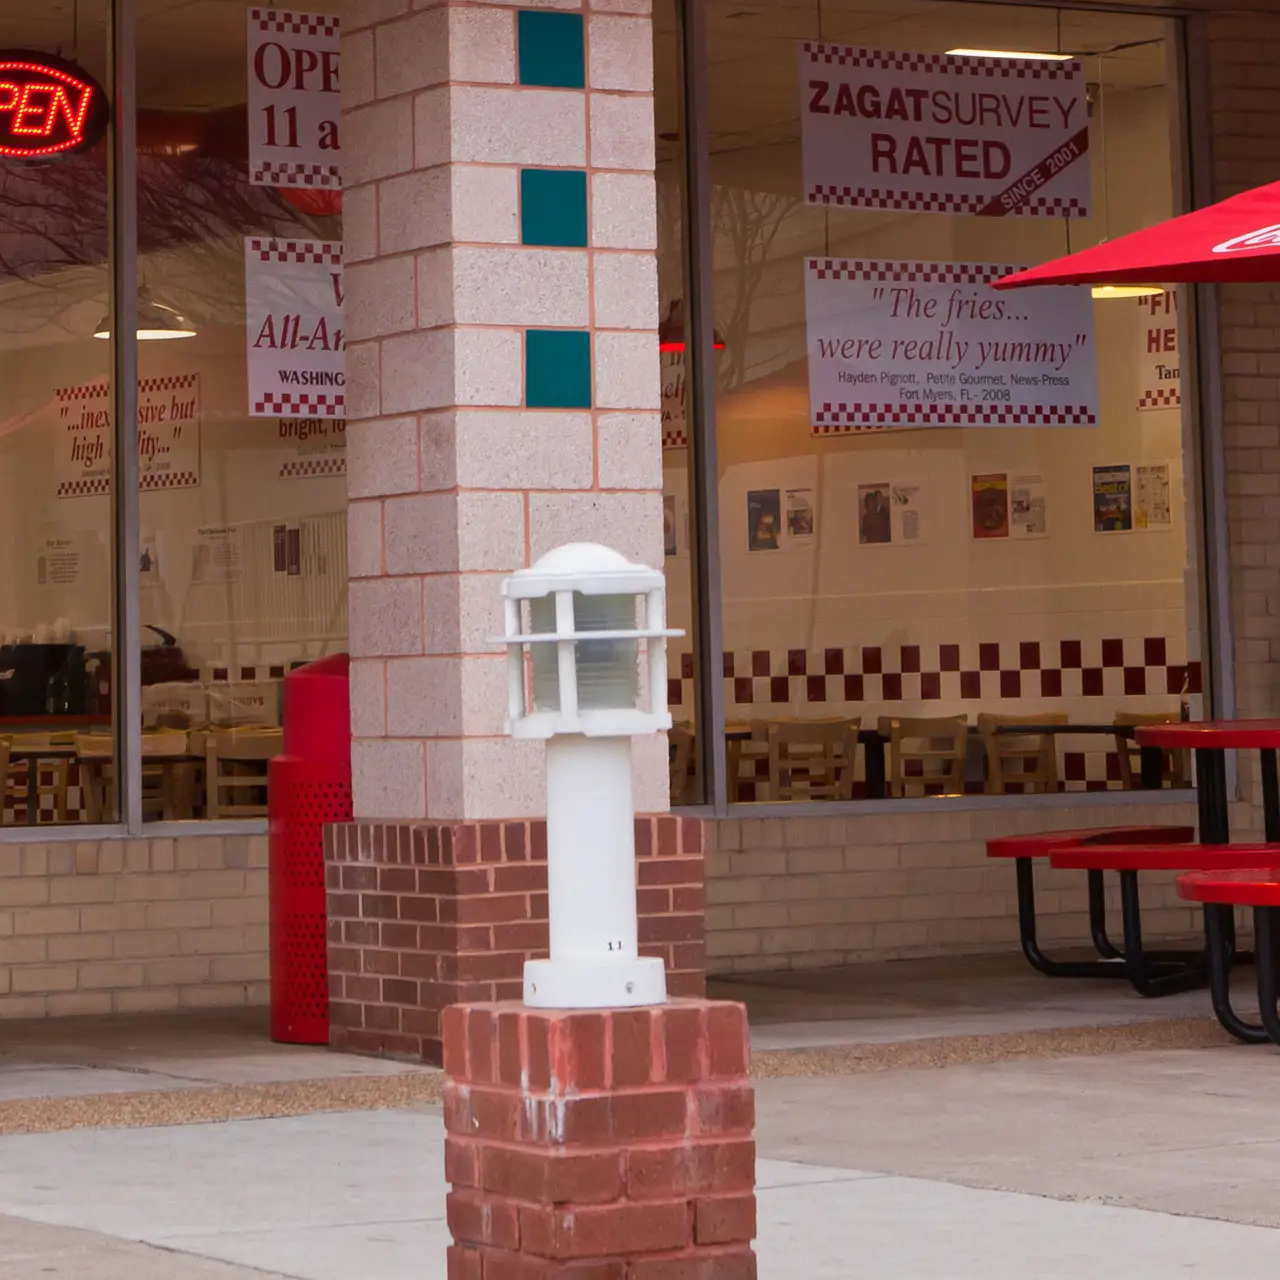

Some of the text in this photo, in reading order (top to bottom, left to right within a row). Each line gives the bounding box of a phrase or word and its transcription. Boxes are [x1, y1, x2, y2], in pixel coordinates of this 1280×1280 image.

[808, 80, 1078, 130] ZAGATSURVEY
[260, 105, 300, 149] 11
[870, 133, 1012, 180] RATED
[999, 140, 1081, 211] SINCE 2001
[872, 287, 1031, 327] "The fries...
[817, 330, 1087, 371] were really yummy"
[837, 371, 878, 385] Hayden
[926, 372, 957, 386] Petite
[1010, 373, 1071, 388] News-Press
[899, 387, 921, 401] Fort
[922, 387, 957, 403] Myers,
[981, 388, 1012, 402] 2008
[169, 394, 196, 420] but
[71, 434, 104, 468] high
